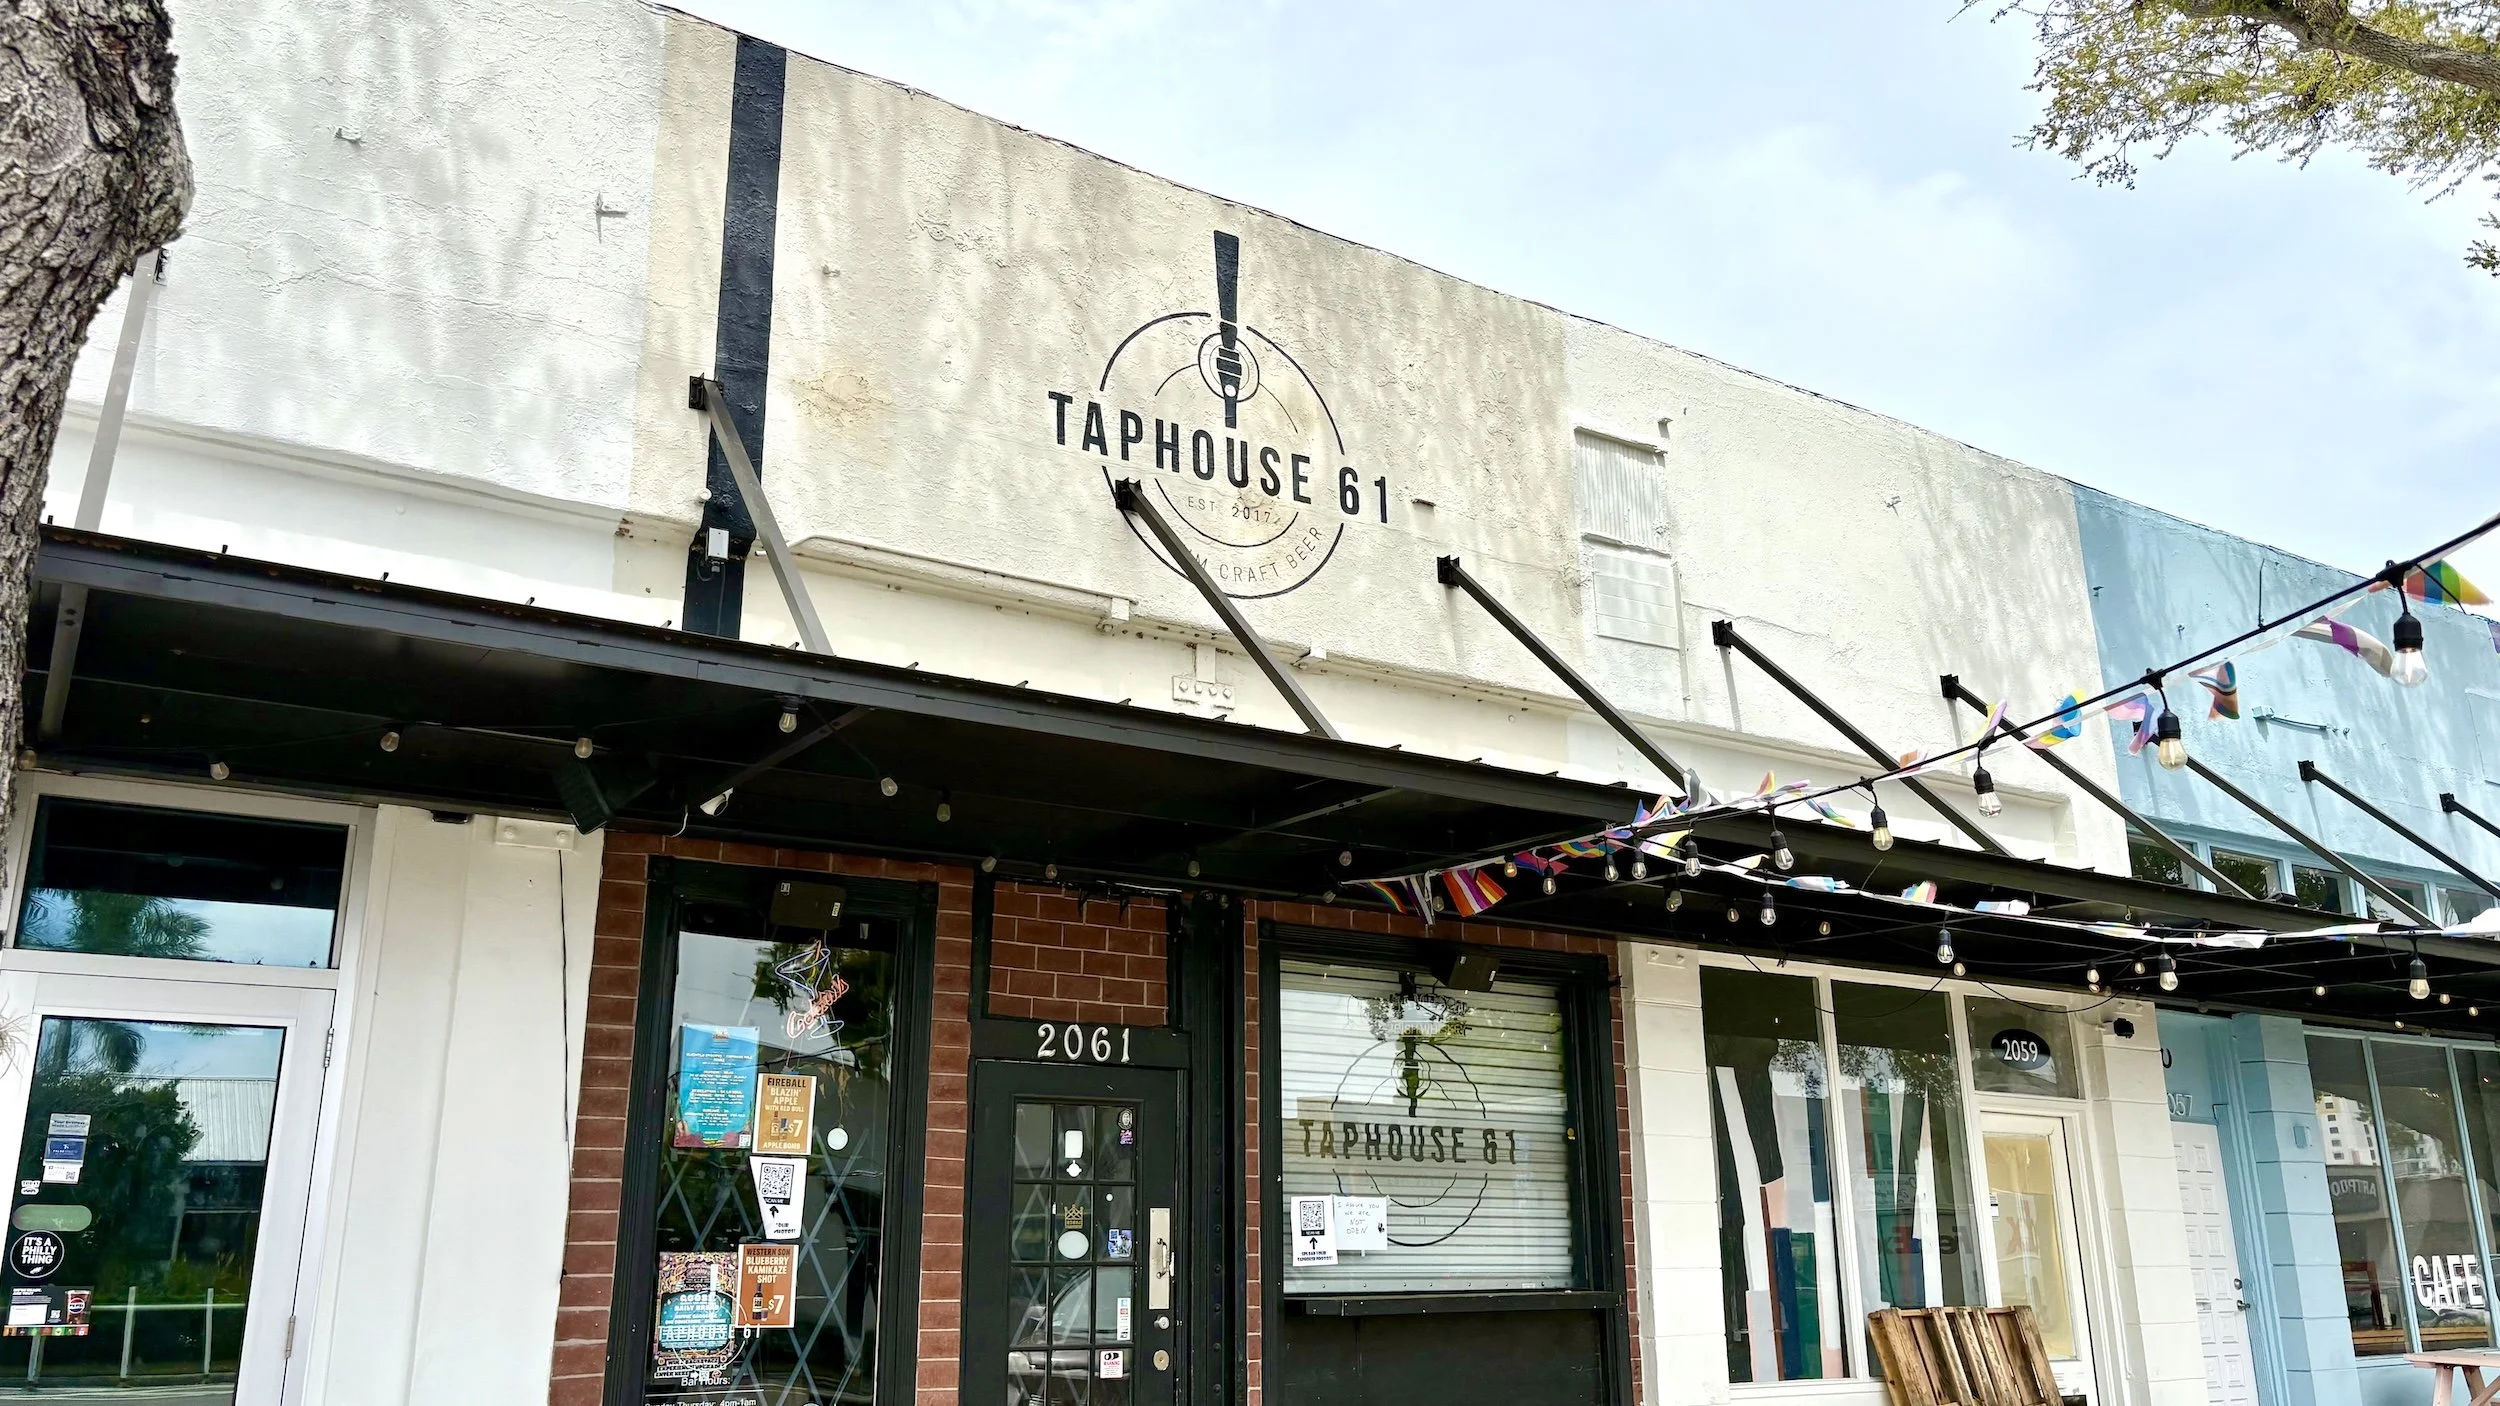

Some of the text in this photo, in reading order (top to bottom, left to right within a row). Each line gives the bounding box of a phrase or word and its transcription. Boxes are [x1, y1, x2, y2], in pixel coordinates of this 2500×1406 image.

[1048, 391, 1388, 524] TAPHOUSE 61
[1188, 496, 1271, 524] EST 2017
[1219, 527, 1323, 583] CRAFT BEER
[1037, 1023, 1131, 1064] 2061
[2001, 1038, 2039, 1063] 2059
[767, 1077, 807, 1087] FIREBALL
[773, 1097, 798, 1105] APPLE
[2167, 1093, 2193, 1116] 057
[789, 1120, 803, 1138] $7
[1299, 1119, 1517, 1165] TAPHOUSE 61
[24, 1237, 51, 1246] IT'S A
[22, 1246, 57, 1255] PHILLY
[746, 1248, 776, 1256] WESTERN
[22, 1255, 54, 1264] THING
[746, 1256, 789, 1265] BLUEBERRY
[748, 1265, 787, 1274] KAMIKAZE
[757, 1274, 777, 1283] SHOT
[2412, 1254, 2485, 1309] CAFE
[768, 1295, 784, 1315] $7
[743, 1323, 761, 1339] 61
[681, 1376, 730, 1386] Bar Hours:
